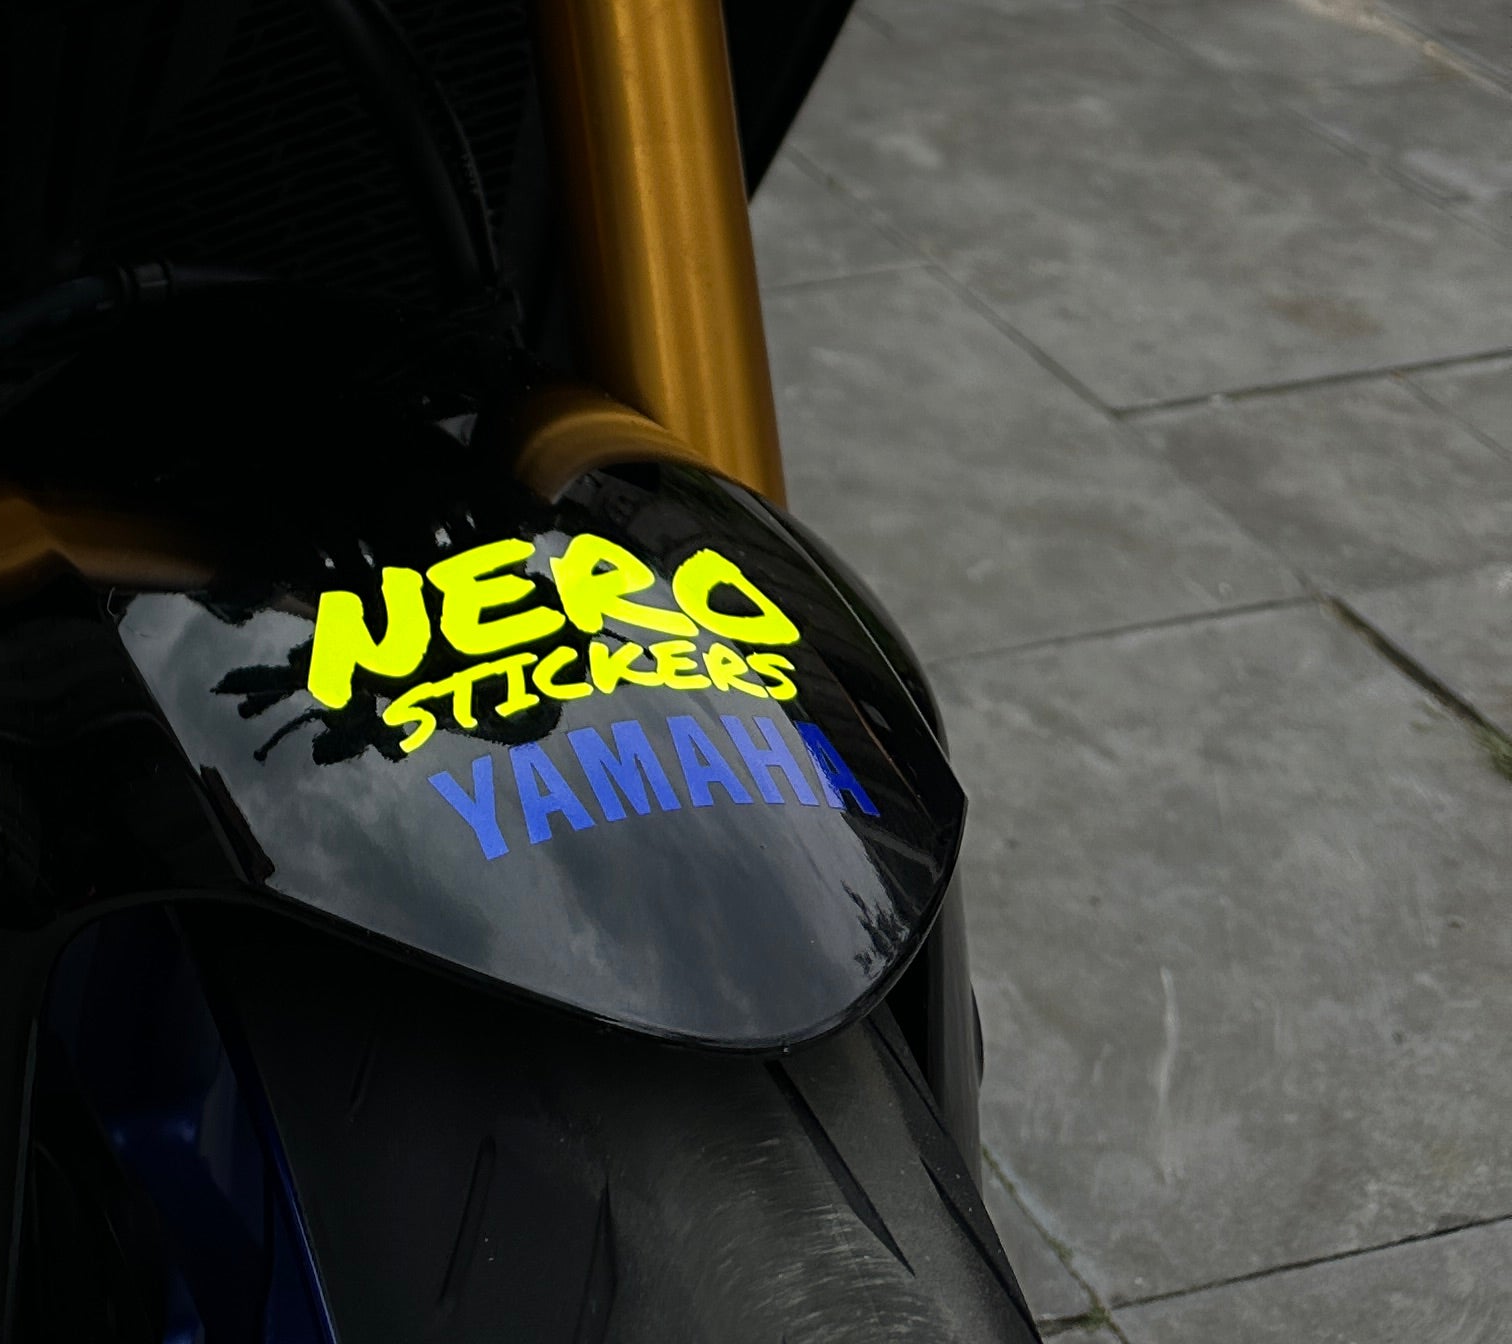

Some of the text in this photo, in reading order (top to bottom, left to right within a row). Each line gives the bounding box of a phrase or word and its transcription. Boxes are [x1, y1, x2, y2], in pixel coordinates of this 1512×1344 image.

[308, 533, 800, 709] NERO
[383, 639, 798, 753] STICKERS
[428, 715, 880, 859] YAMAHA
